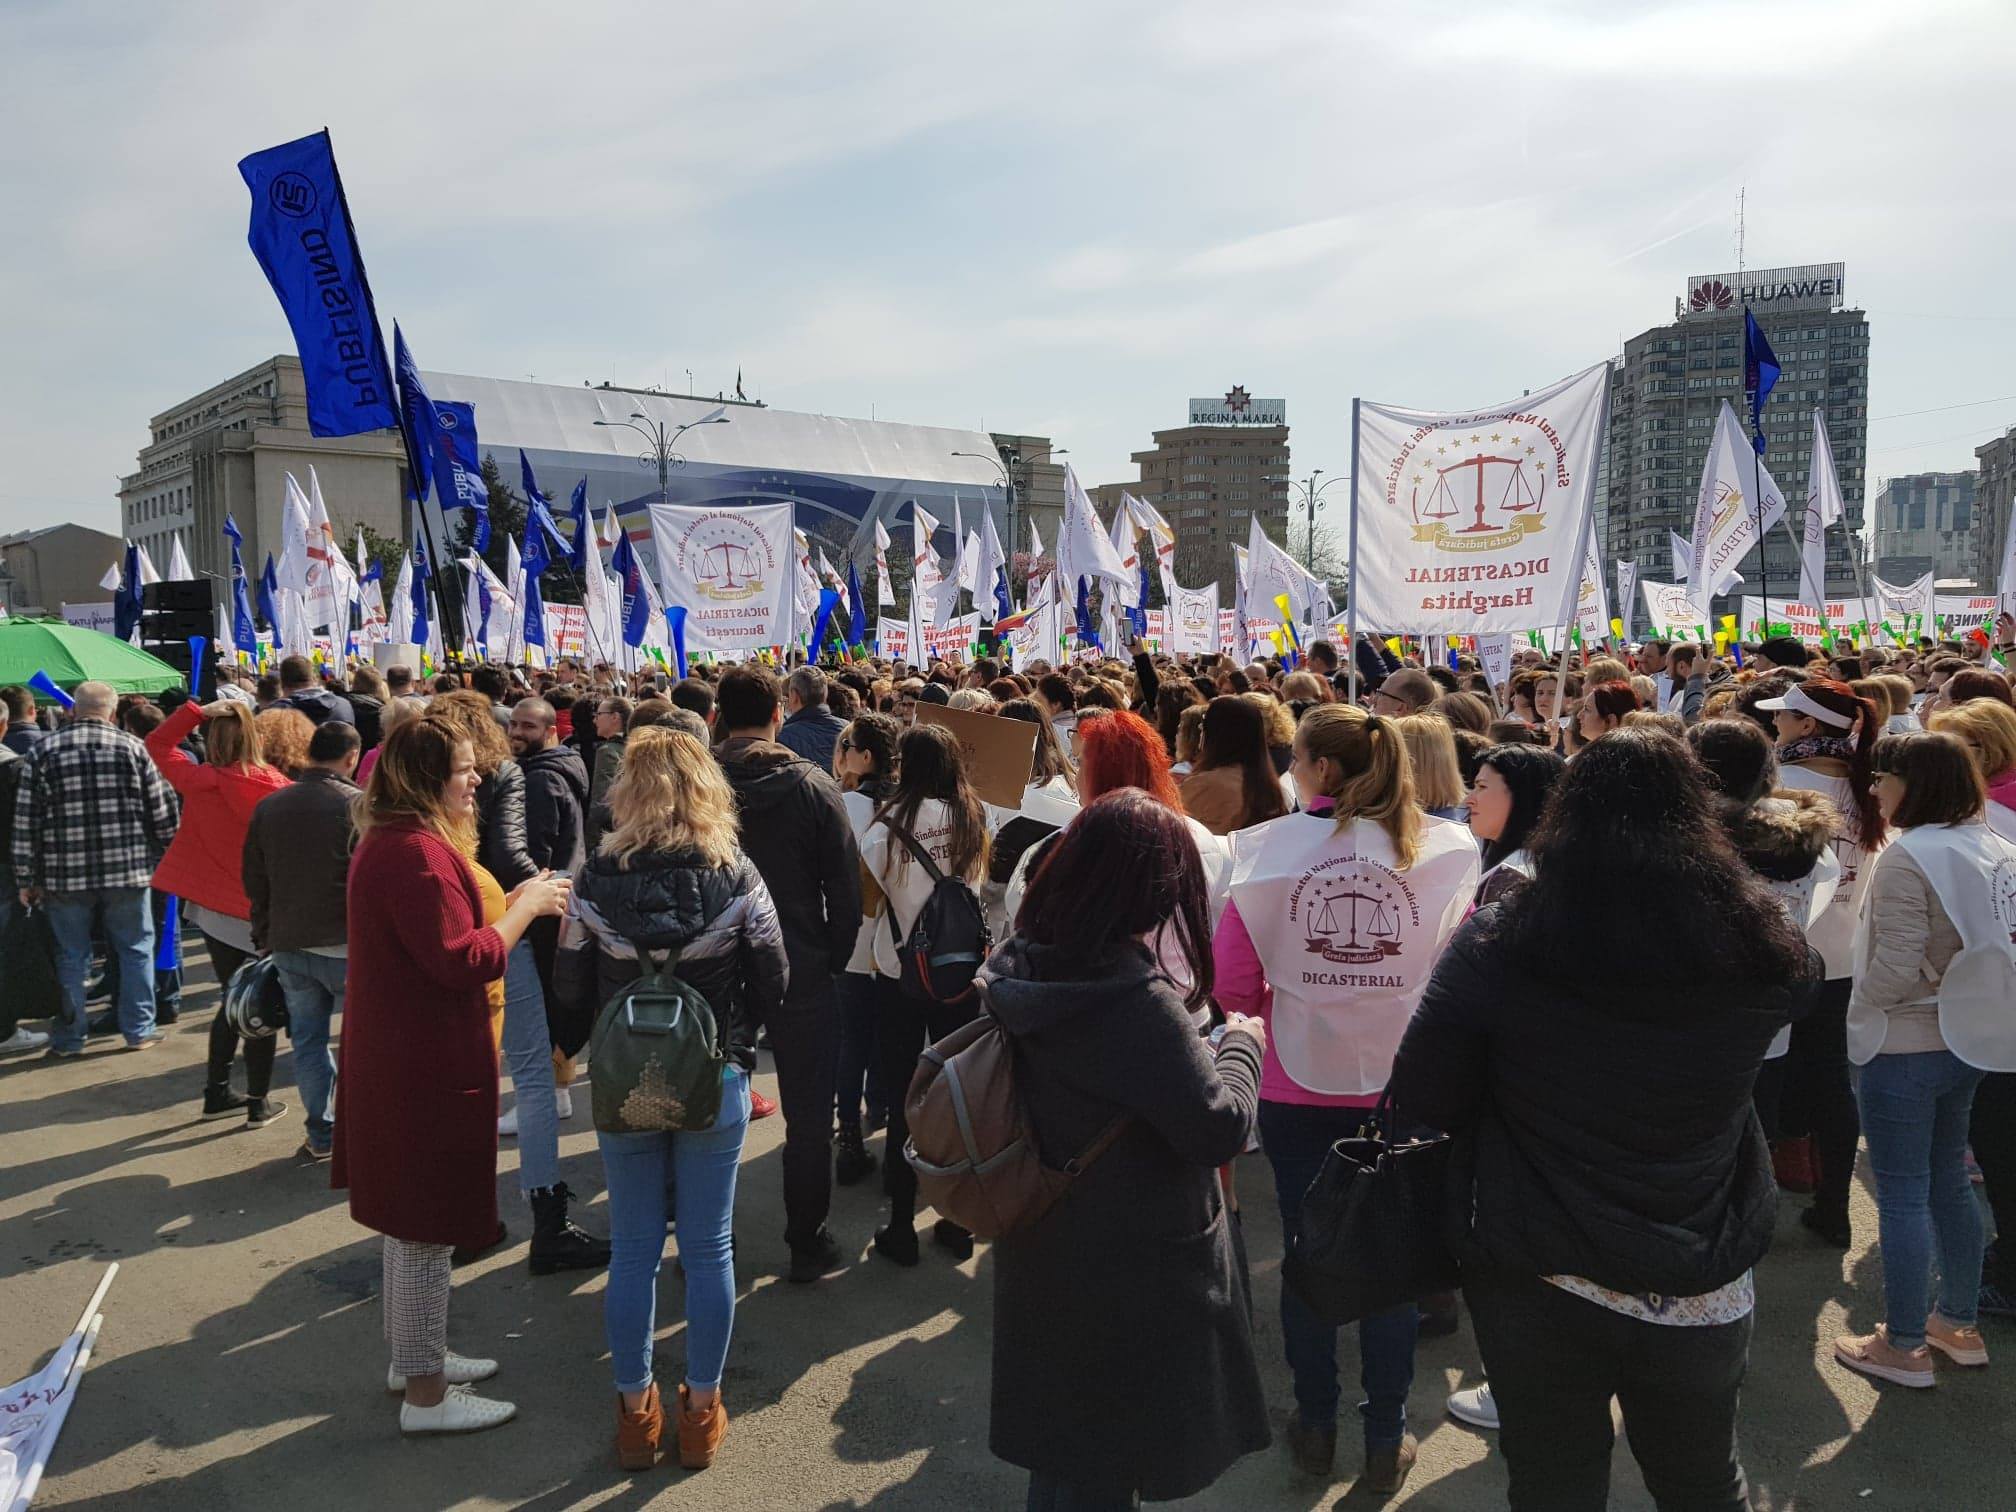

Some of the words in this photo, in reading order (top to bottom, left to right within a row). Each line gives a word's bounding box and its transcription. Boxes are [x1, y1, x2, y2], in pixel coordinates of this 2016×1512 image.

[1740, 278, 1842, 304] HUAWEI
[1192, 413, 1238, 424] REGINA
[1241, 413, 1282, 424] MARIA
[94, 615, 115, 626] MAR
[1289, 869, 1314, 923] Sindicatul
[1397, 879, 1420, 928] Judiciare
[1301, 971, 1404, 988] DICASTERIAL
